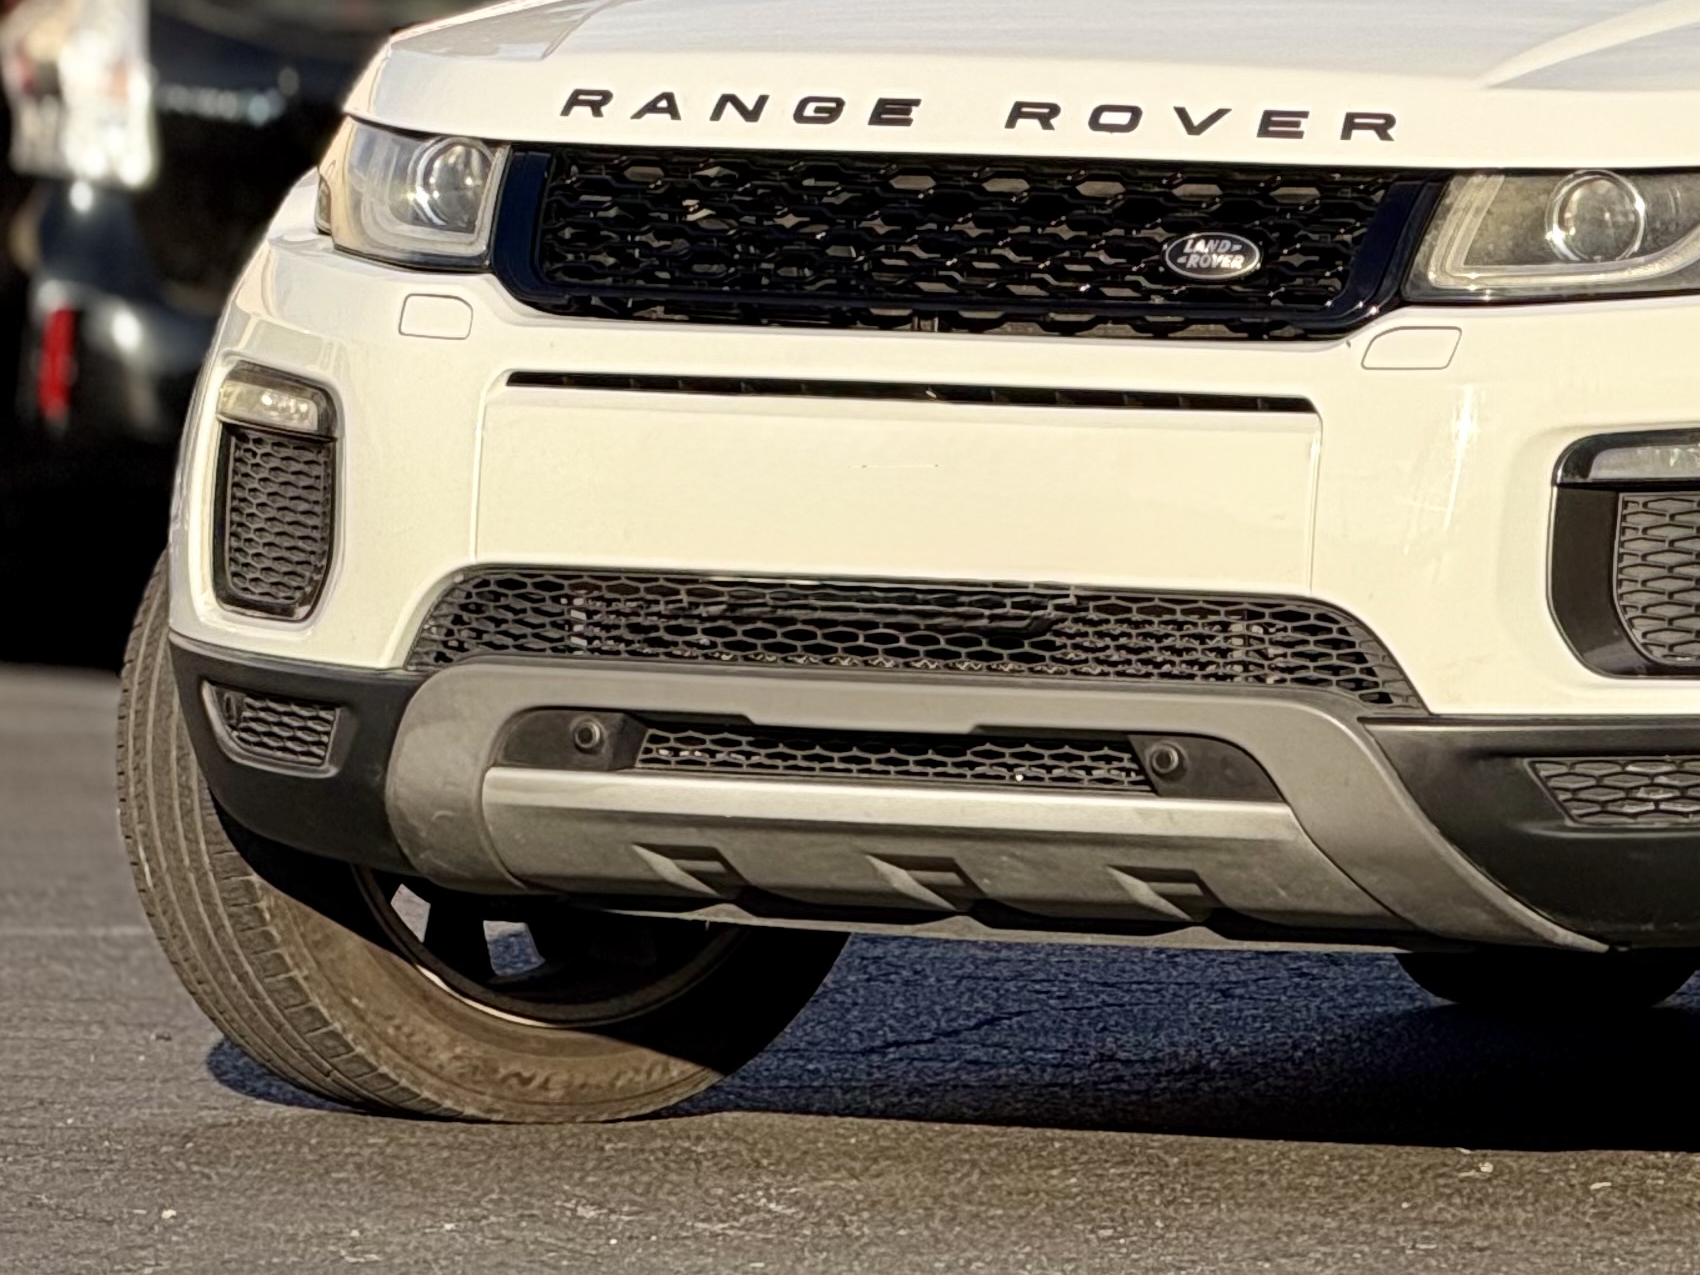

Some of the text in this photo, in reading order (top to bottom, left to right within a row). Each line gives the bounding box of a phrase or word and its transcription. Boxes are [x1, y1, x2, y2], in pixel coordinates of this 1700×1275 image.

[559, 88, 1397, 142] RANGE ROVER
[1183, 238, 1232, 254] LAND
[1185, 253, 1245, 270] ROVER
